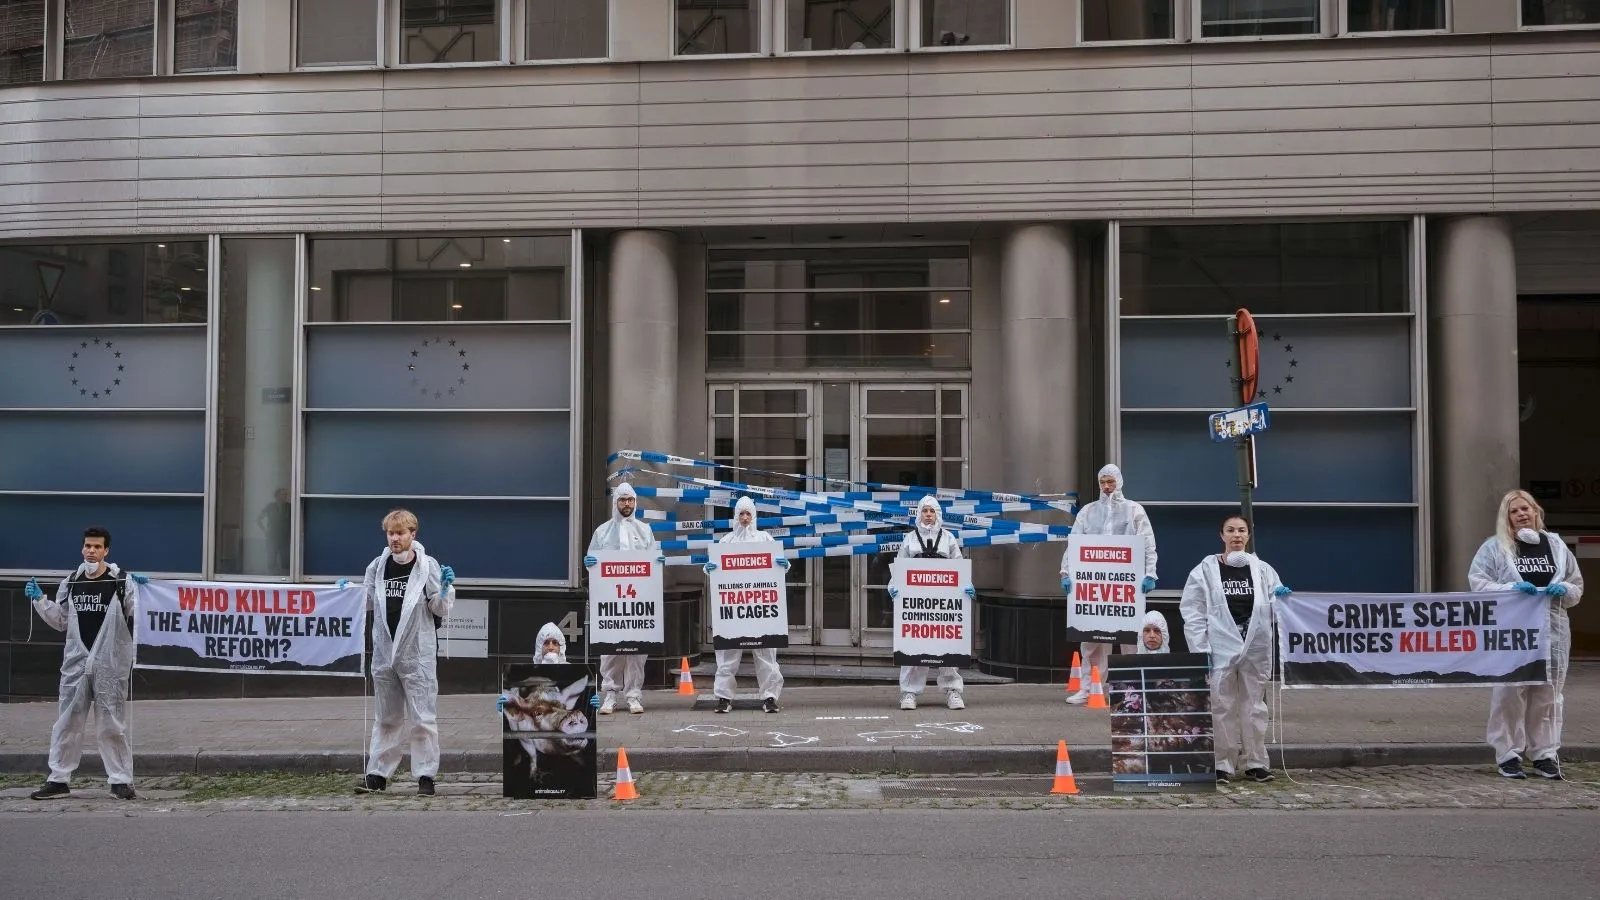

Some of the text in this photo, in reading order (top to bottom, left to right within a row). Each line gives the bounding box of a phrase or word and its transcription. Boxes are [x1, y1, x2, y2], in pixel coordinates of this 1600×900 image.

[725, 556, 768, 567] EVIDENCE
[1084, 549, 1127, 560] EVIDENCE
[605, 564, 647, 574] EVIDENCE
[1517, 564, 1557, 573] QUALIT
[911, 573, 955, 584] EVIDENCE
[1075, 571, 1136, 582] BAN ON CAGES
[1222, 578, 1249, 588] nimal
[616, 584, 637, 598] 1.4
[718, 582, 744, 590] MILLIONS
[1075, 582, 1136, 603] NEVER
[1223, 587, 1254, 595] QUALIT
[177, 586, 316, 615] WHO KILLED
[719, 590, 779, 604] TRAPPED
[902, 597, 963, 611] EUROPEAN
[598, 601, 655, 616] MILLION
[720, 605, 779, 620] IN CAGES
[1075, 603, 1136, 617] DELIVERED
[1327, 600, 1498, 629] CRIME SCENE
[901, 611, 963, 622] COMMISSION'S
[147, 611, 353, 638] THE ANIMAL WELFARE
[558, 610, 583, 643] 4
[598, 619, 656, 630] SIGNATURES
[901, 623, 963, 640] PROMISE
[205, 636, 292, 658] REFORM?
[1288, 628, 1540, 654] PROMISES KILLED HERE
